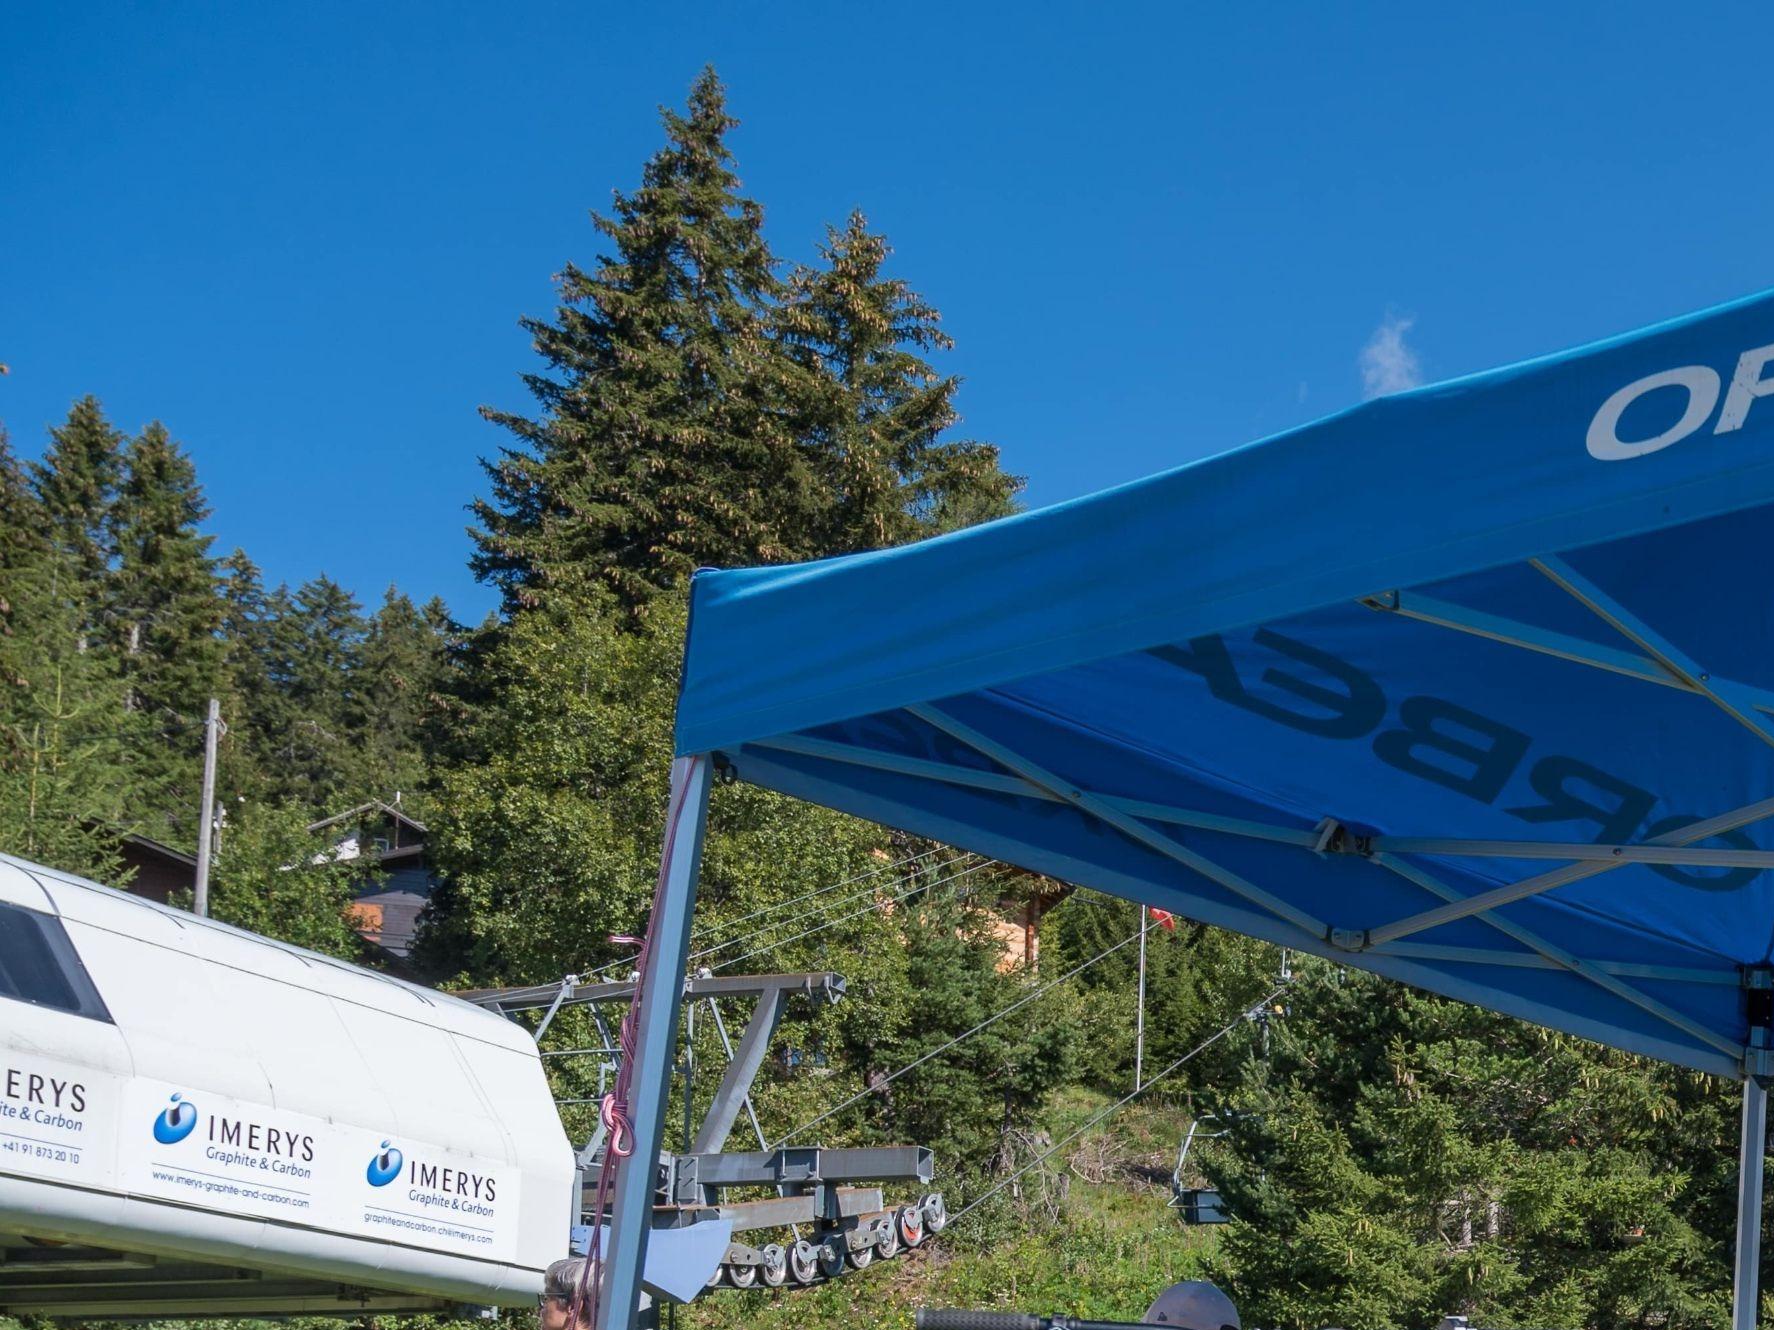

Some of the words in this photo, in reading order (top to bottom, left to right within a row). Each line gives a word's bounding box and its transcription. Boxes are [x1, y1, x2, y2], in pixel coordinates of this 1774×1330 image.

[6, 1068, 86, 1113] ERYS
[19, 1106, 31, 1121] &
[34, 1110, 83, 1131] Carbon
[36, 1147, 53, 1159] 873
[55, 1150, 66, 1162] 20
[209, 1115, 314, 1162] IMERYS
[206, 1146, 257, 1168] Graphite
[259, 1157, 270, 1171] &
[272, 1160, 311, 1179] Carbon
[410, 1161, 496, 1202] IMERYS
[408, 1189, 450, 1208] Graphite
[451, 1199, 460, 1210] &
[461, 1200, 494, 1218] Carbon
